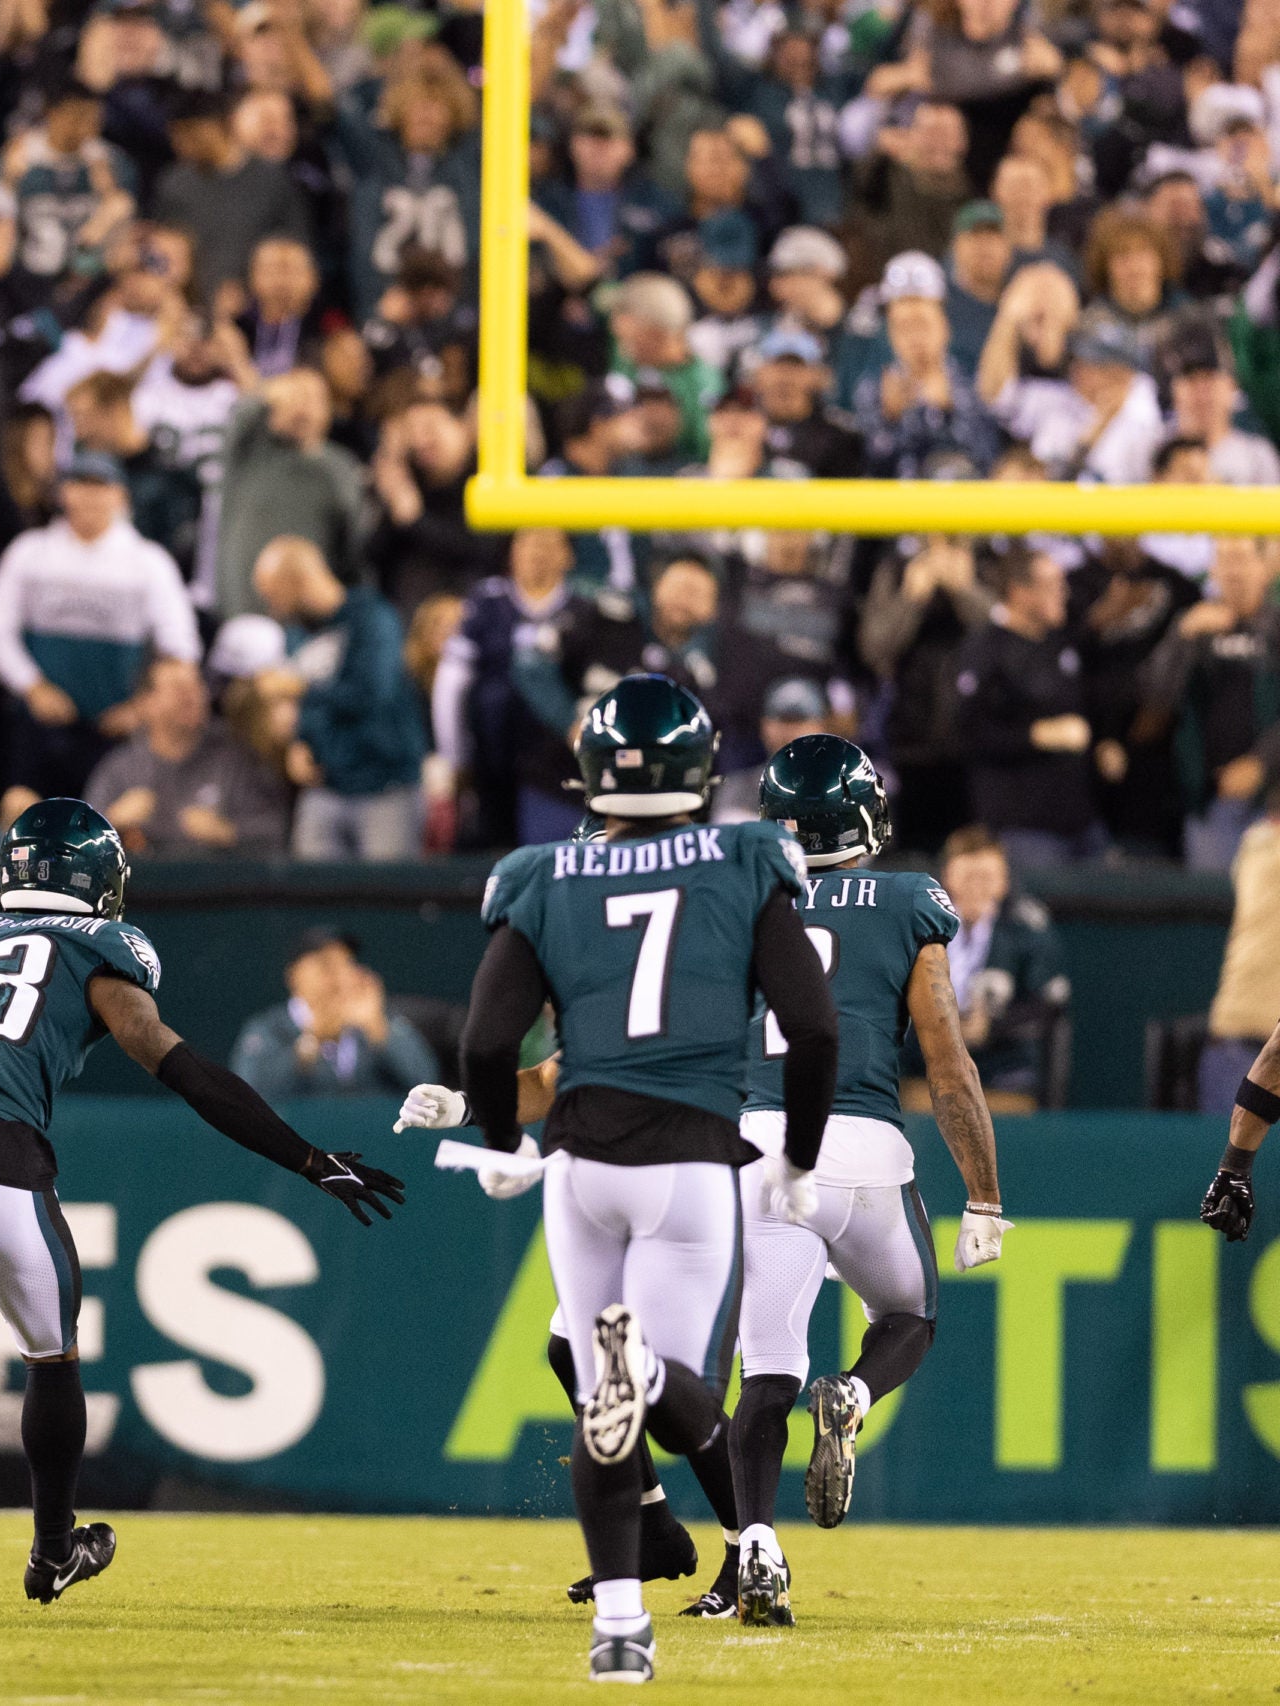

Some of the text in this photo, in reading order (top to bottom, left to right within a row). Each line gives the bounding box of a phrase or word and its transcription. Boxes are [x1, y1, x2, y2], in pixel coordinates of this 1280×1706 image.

[552, 827, 726, 880] REDDICK
[831, 878, 878, 908] JR
[607, 889, 679, 1037] 7
